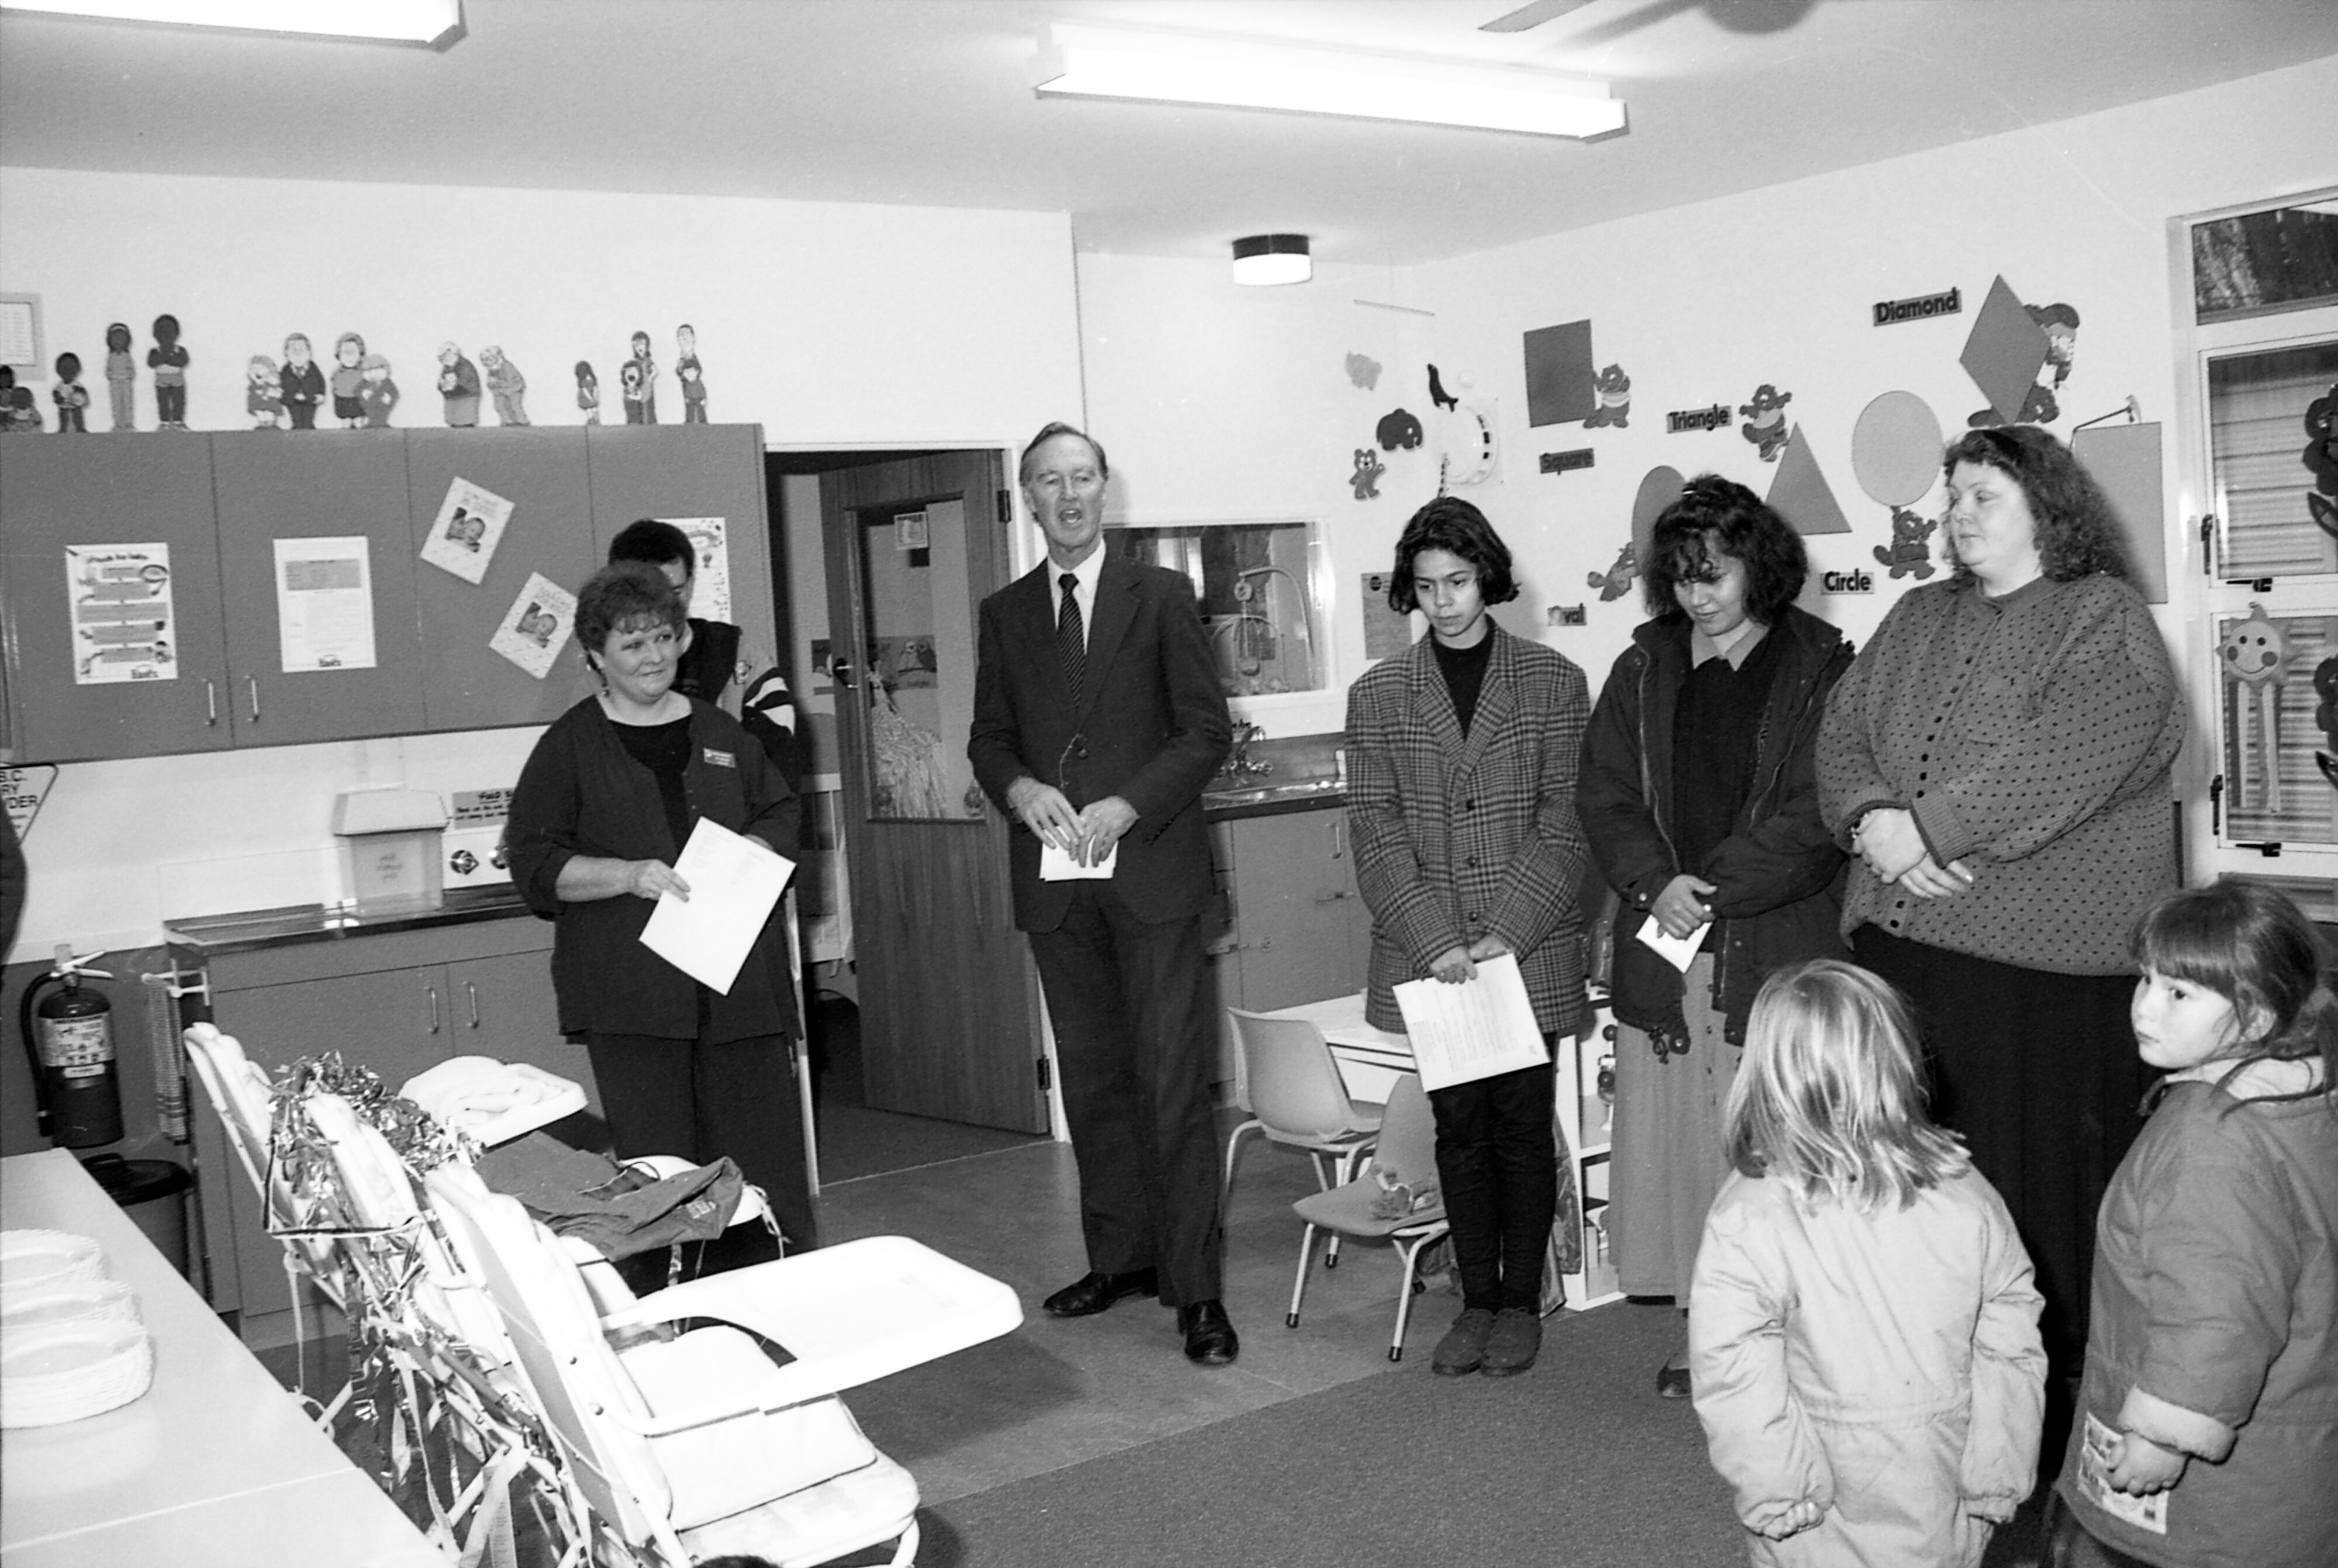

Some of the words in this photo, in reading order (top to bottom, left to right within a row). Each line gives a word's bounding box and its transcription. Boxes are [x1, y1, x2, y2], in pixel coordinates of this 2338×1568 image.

[1876, 286, 1958, 322] Diamond
[1668, 403, 1729, 431] Triangle
[1541, 453, 1592, 475] Square
[1824, 568, 1871, 591] Circle
